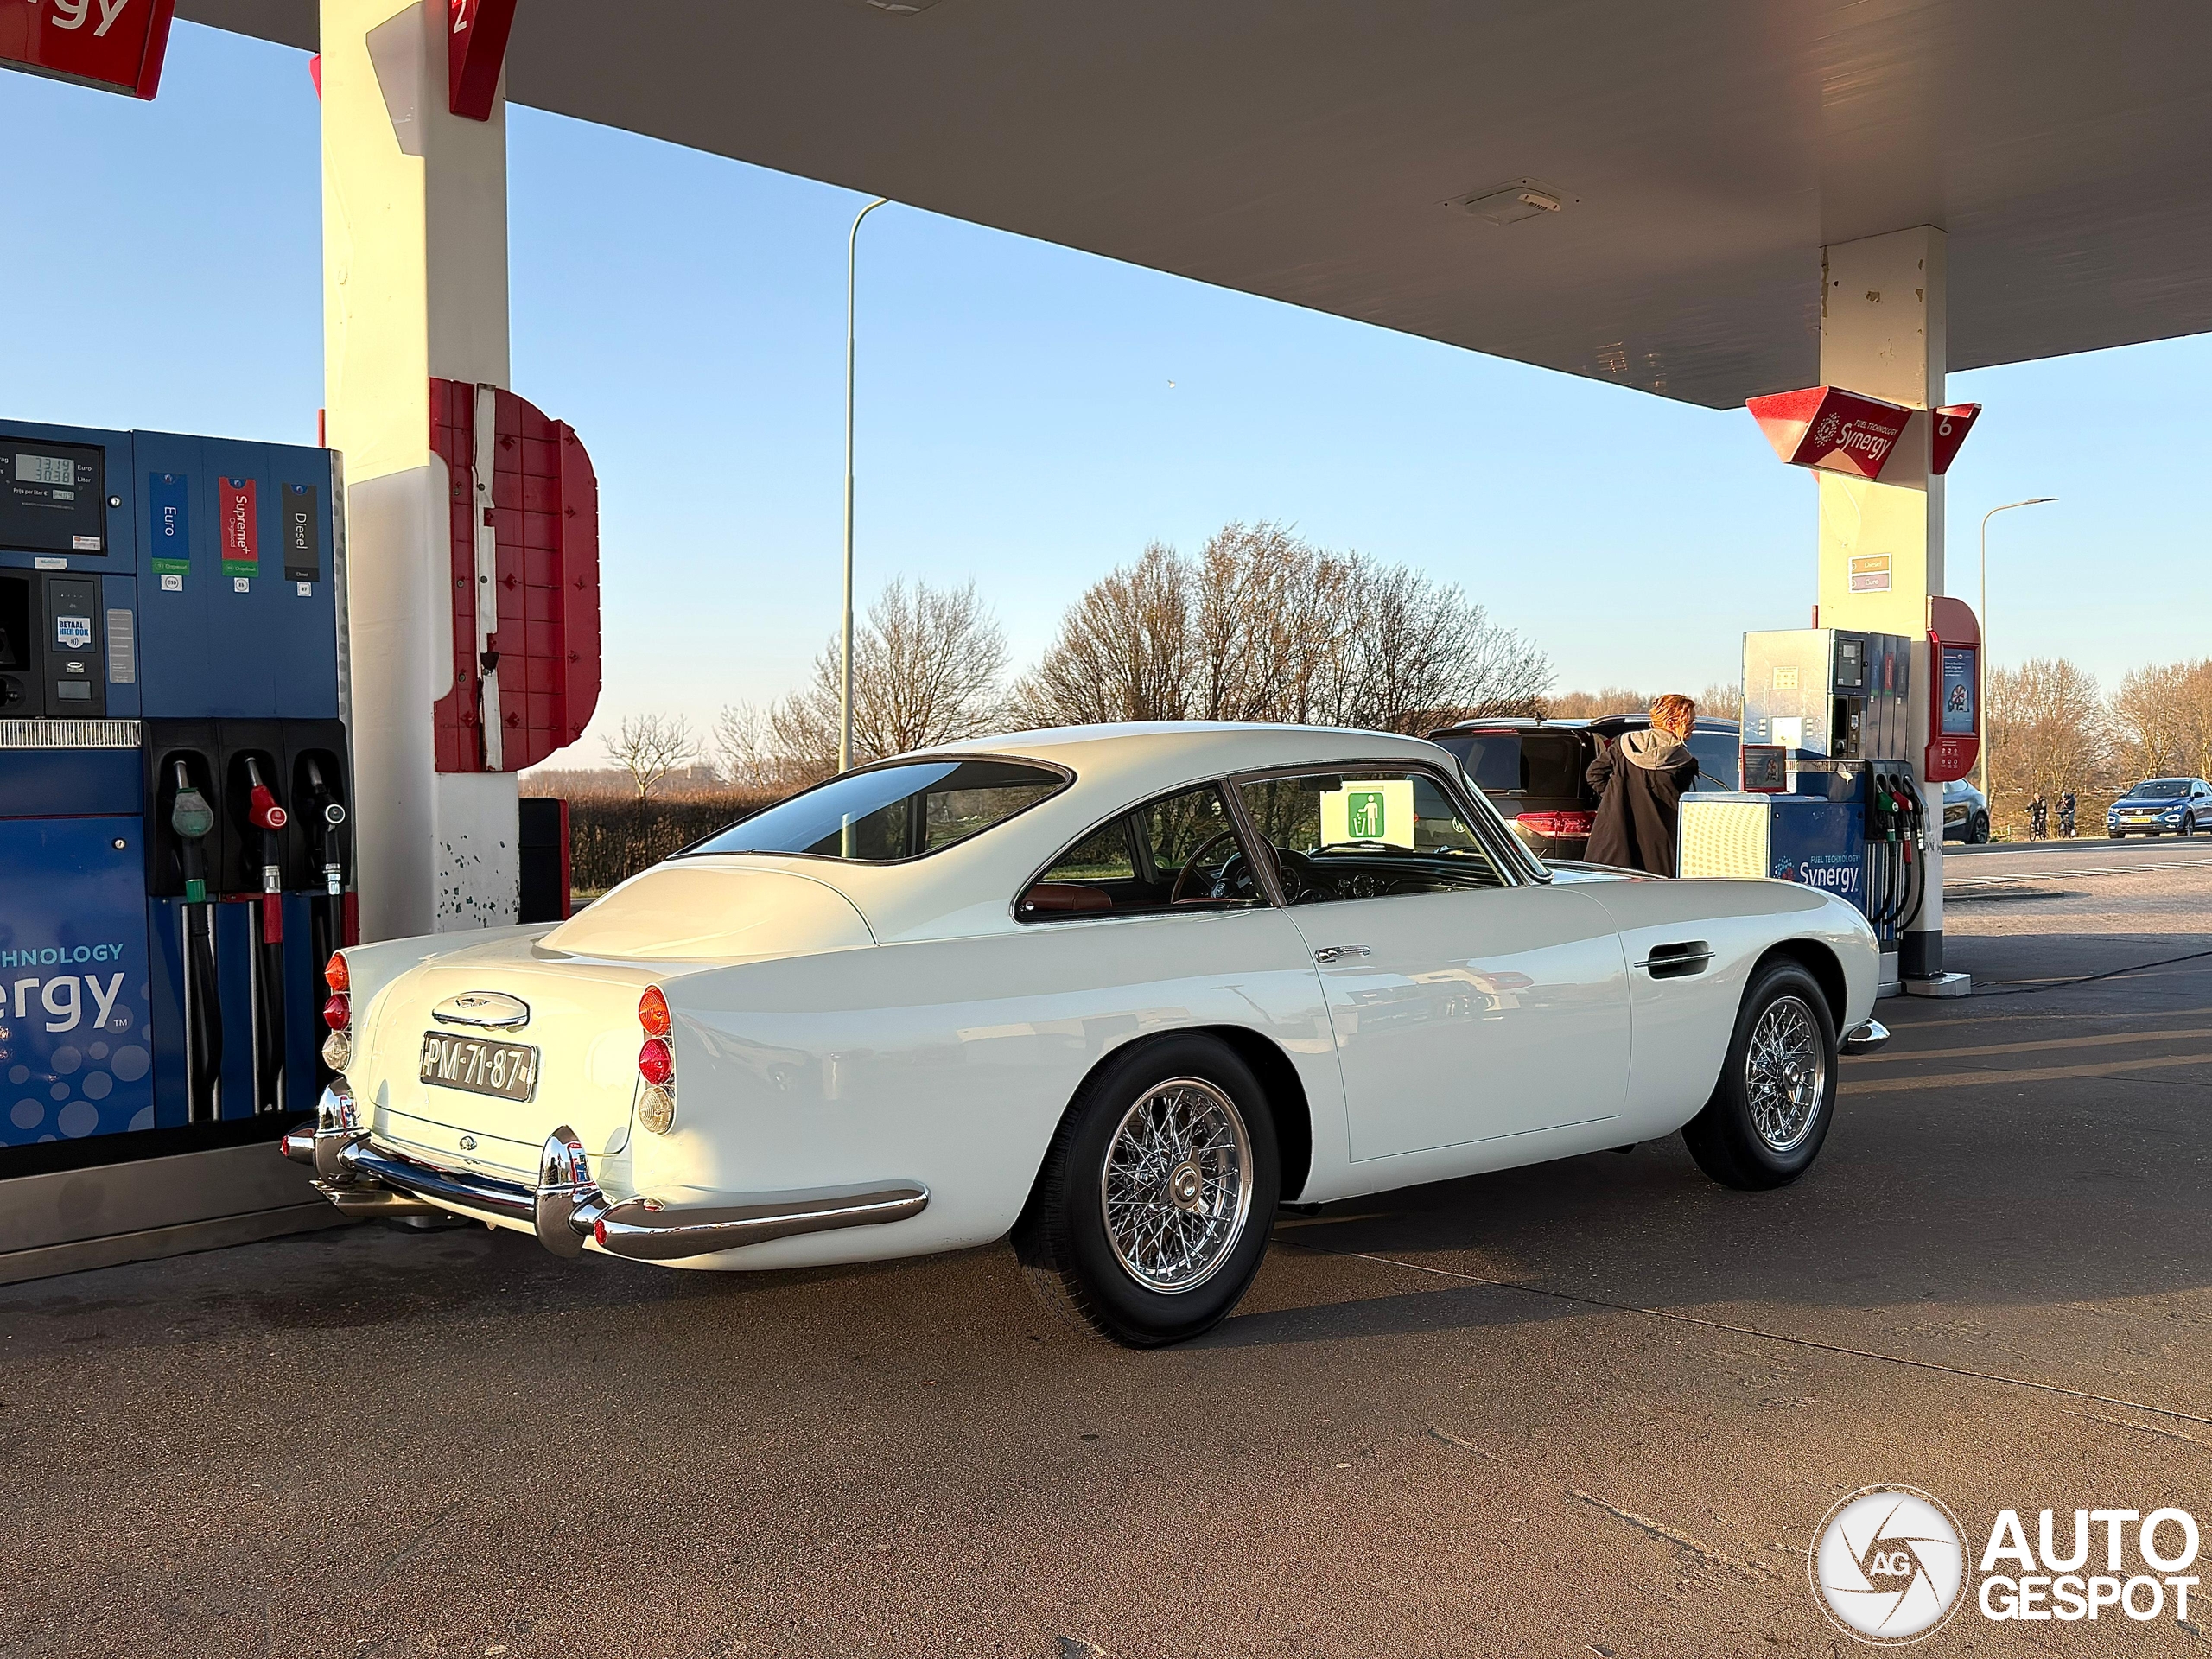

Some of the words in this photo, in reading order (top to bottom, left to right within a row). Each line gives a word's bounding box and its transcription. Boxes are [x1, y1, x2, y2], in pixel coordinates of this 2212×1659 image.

[52, 0, 128, 37] gy
[454, 0, 467, 34] 2
[1835, 423, 1892, 461] Synergy
[1854, 419, 1867, 429] FUEL
[1867, 423, 1898, 436] TECHNOLOGY
[1939, 416, 1952, 437] 6
[164, 506, 176, 537] Euro
[233, 495, 251, 554] Supreme+
[296, 512, 308, 550] Diesel
[59, 620, 84, 629] BETAAL
[1810, 855, 1824, 864] FUEL
[1825, 855, 1859, 863] TECHNOLOGY
[1800, 861, 1859, 893] Synergy
[0, 944, 124, 968] HNOLOGY
[426, 1039, 524, 1091] PM-71-87
